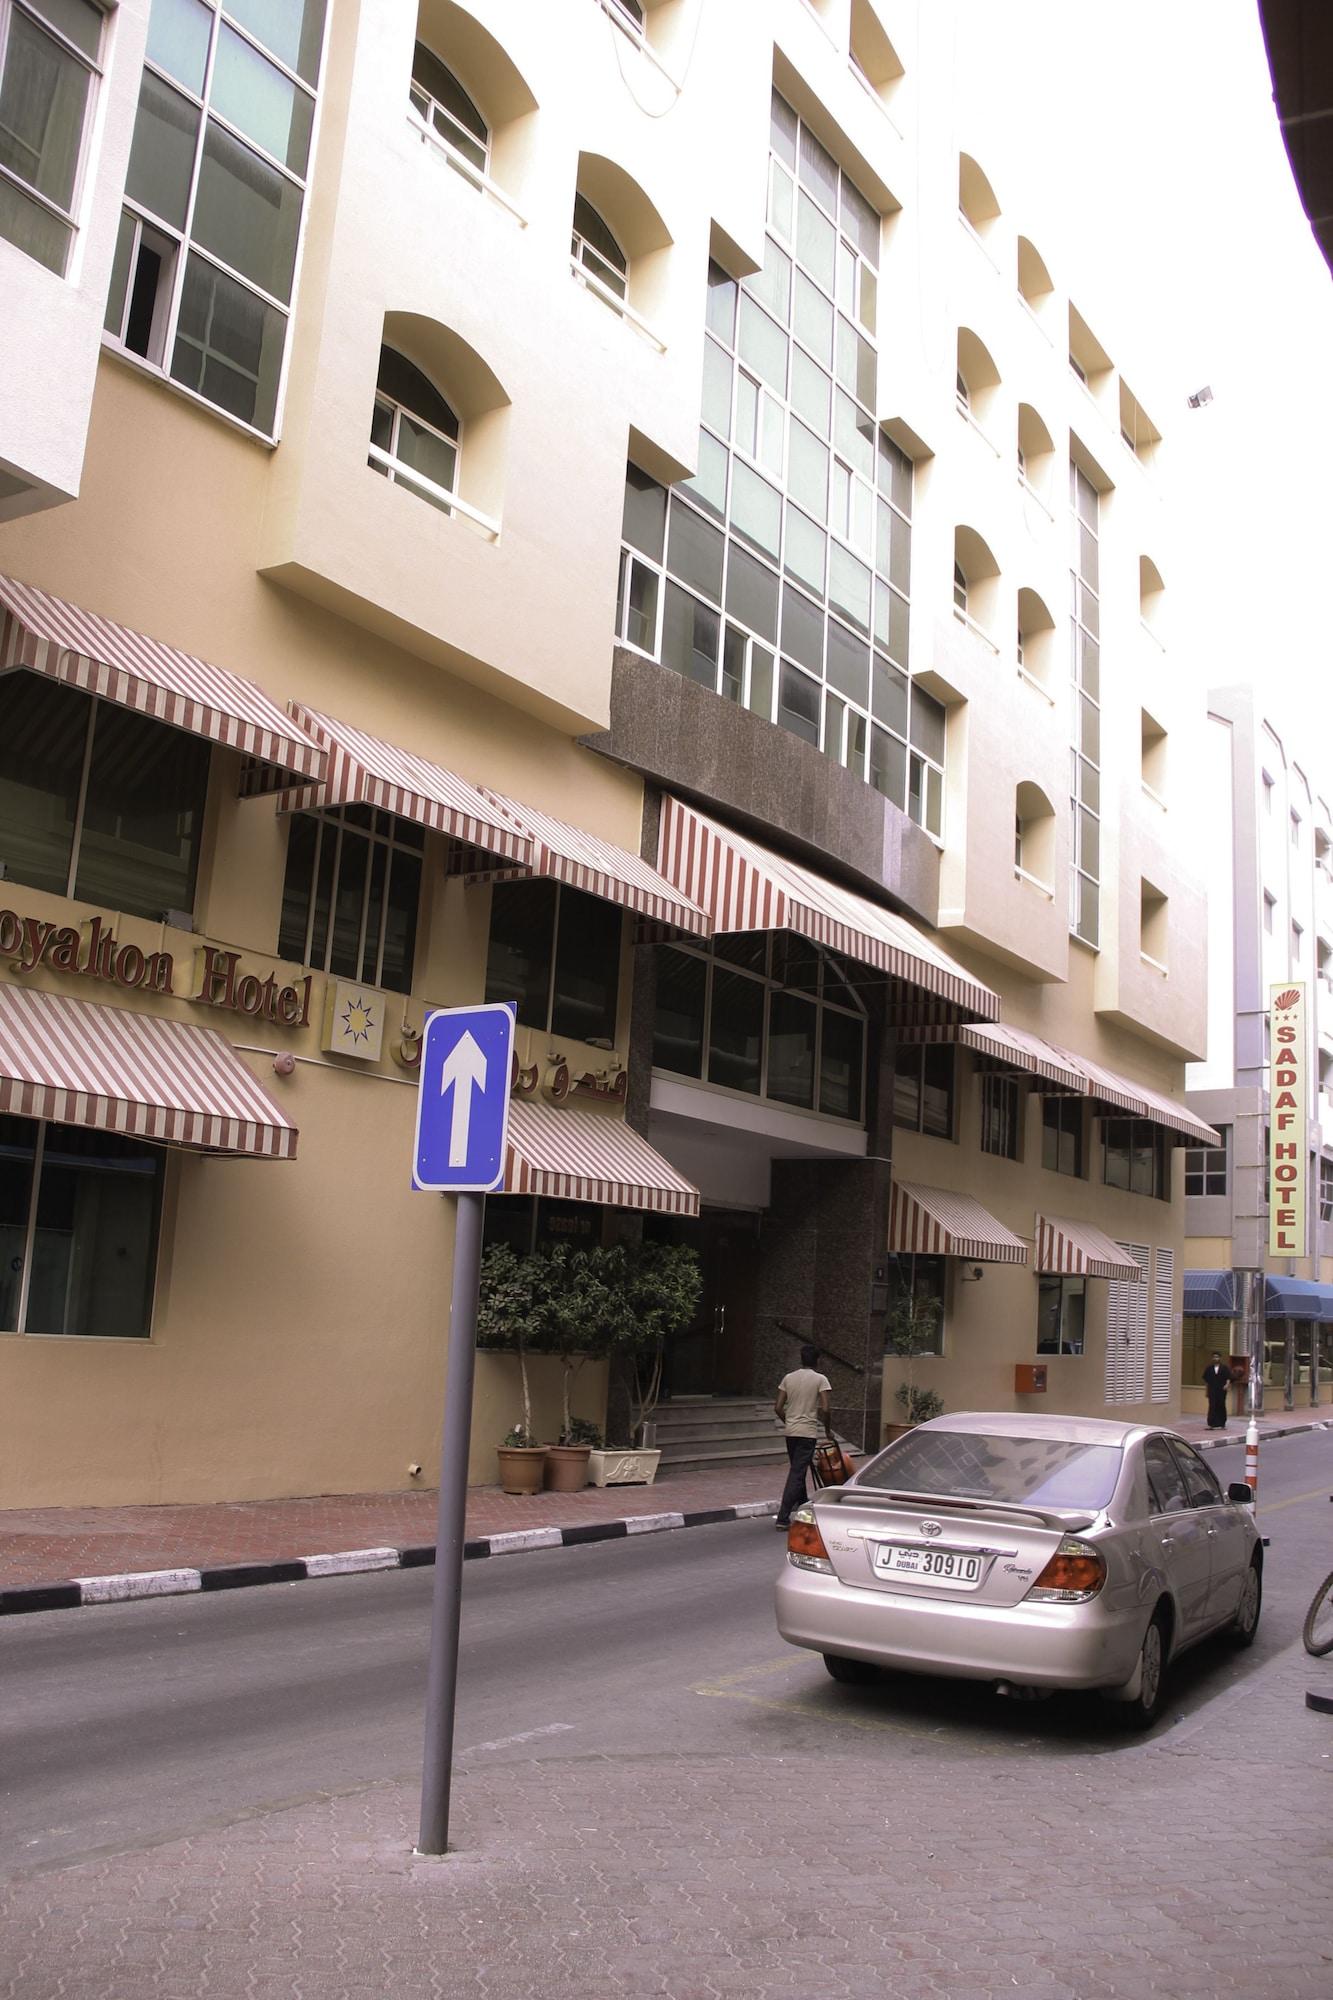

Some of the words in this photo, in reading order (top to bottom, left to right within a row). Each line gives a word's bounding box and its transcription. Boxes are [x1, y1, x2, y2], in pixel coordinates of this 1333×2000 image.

[199, 945, 313, 1028] Hotel
[1275, 1026, 1298, 1131] SADAF
[1275, 1142, 1298, 1249] HOTEL
[882, 1548, 892, 1566] J
[923, 1553, 976, 1578] 30910
[896, 1560, 918, 1570] DUBAI
